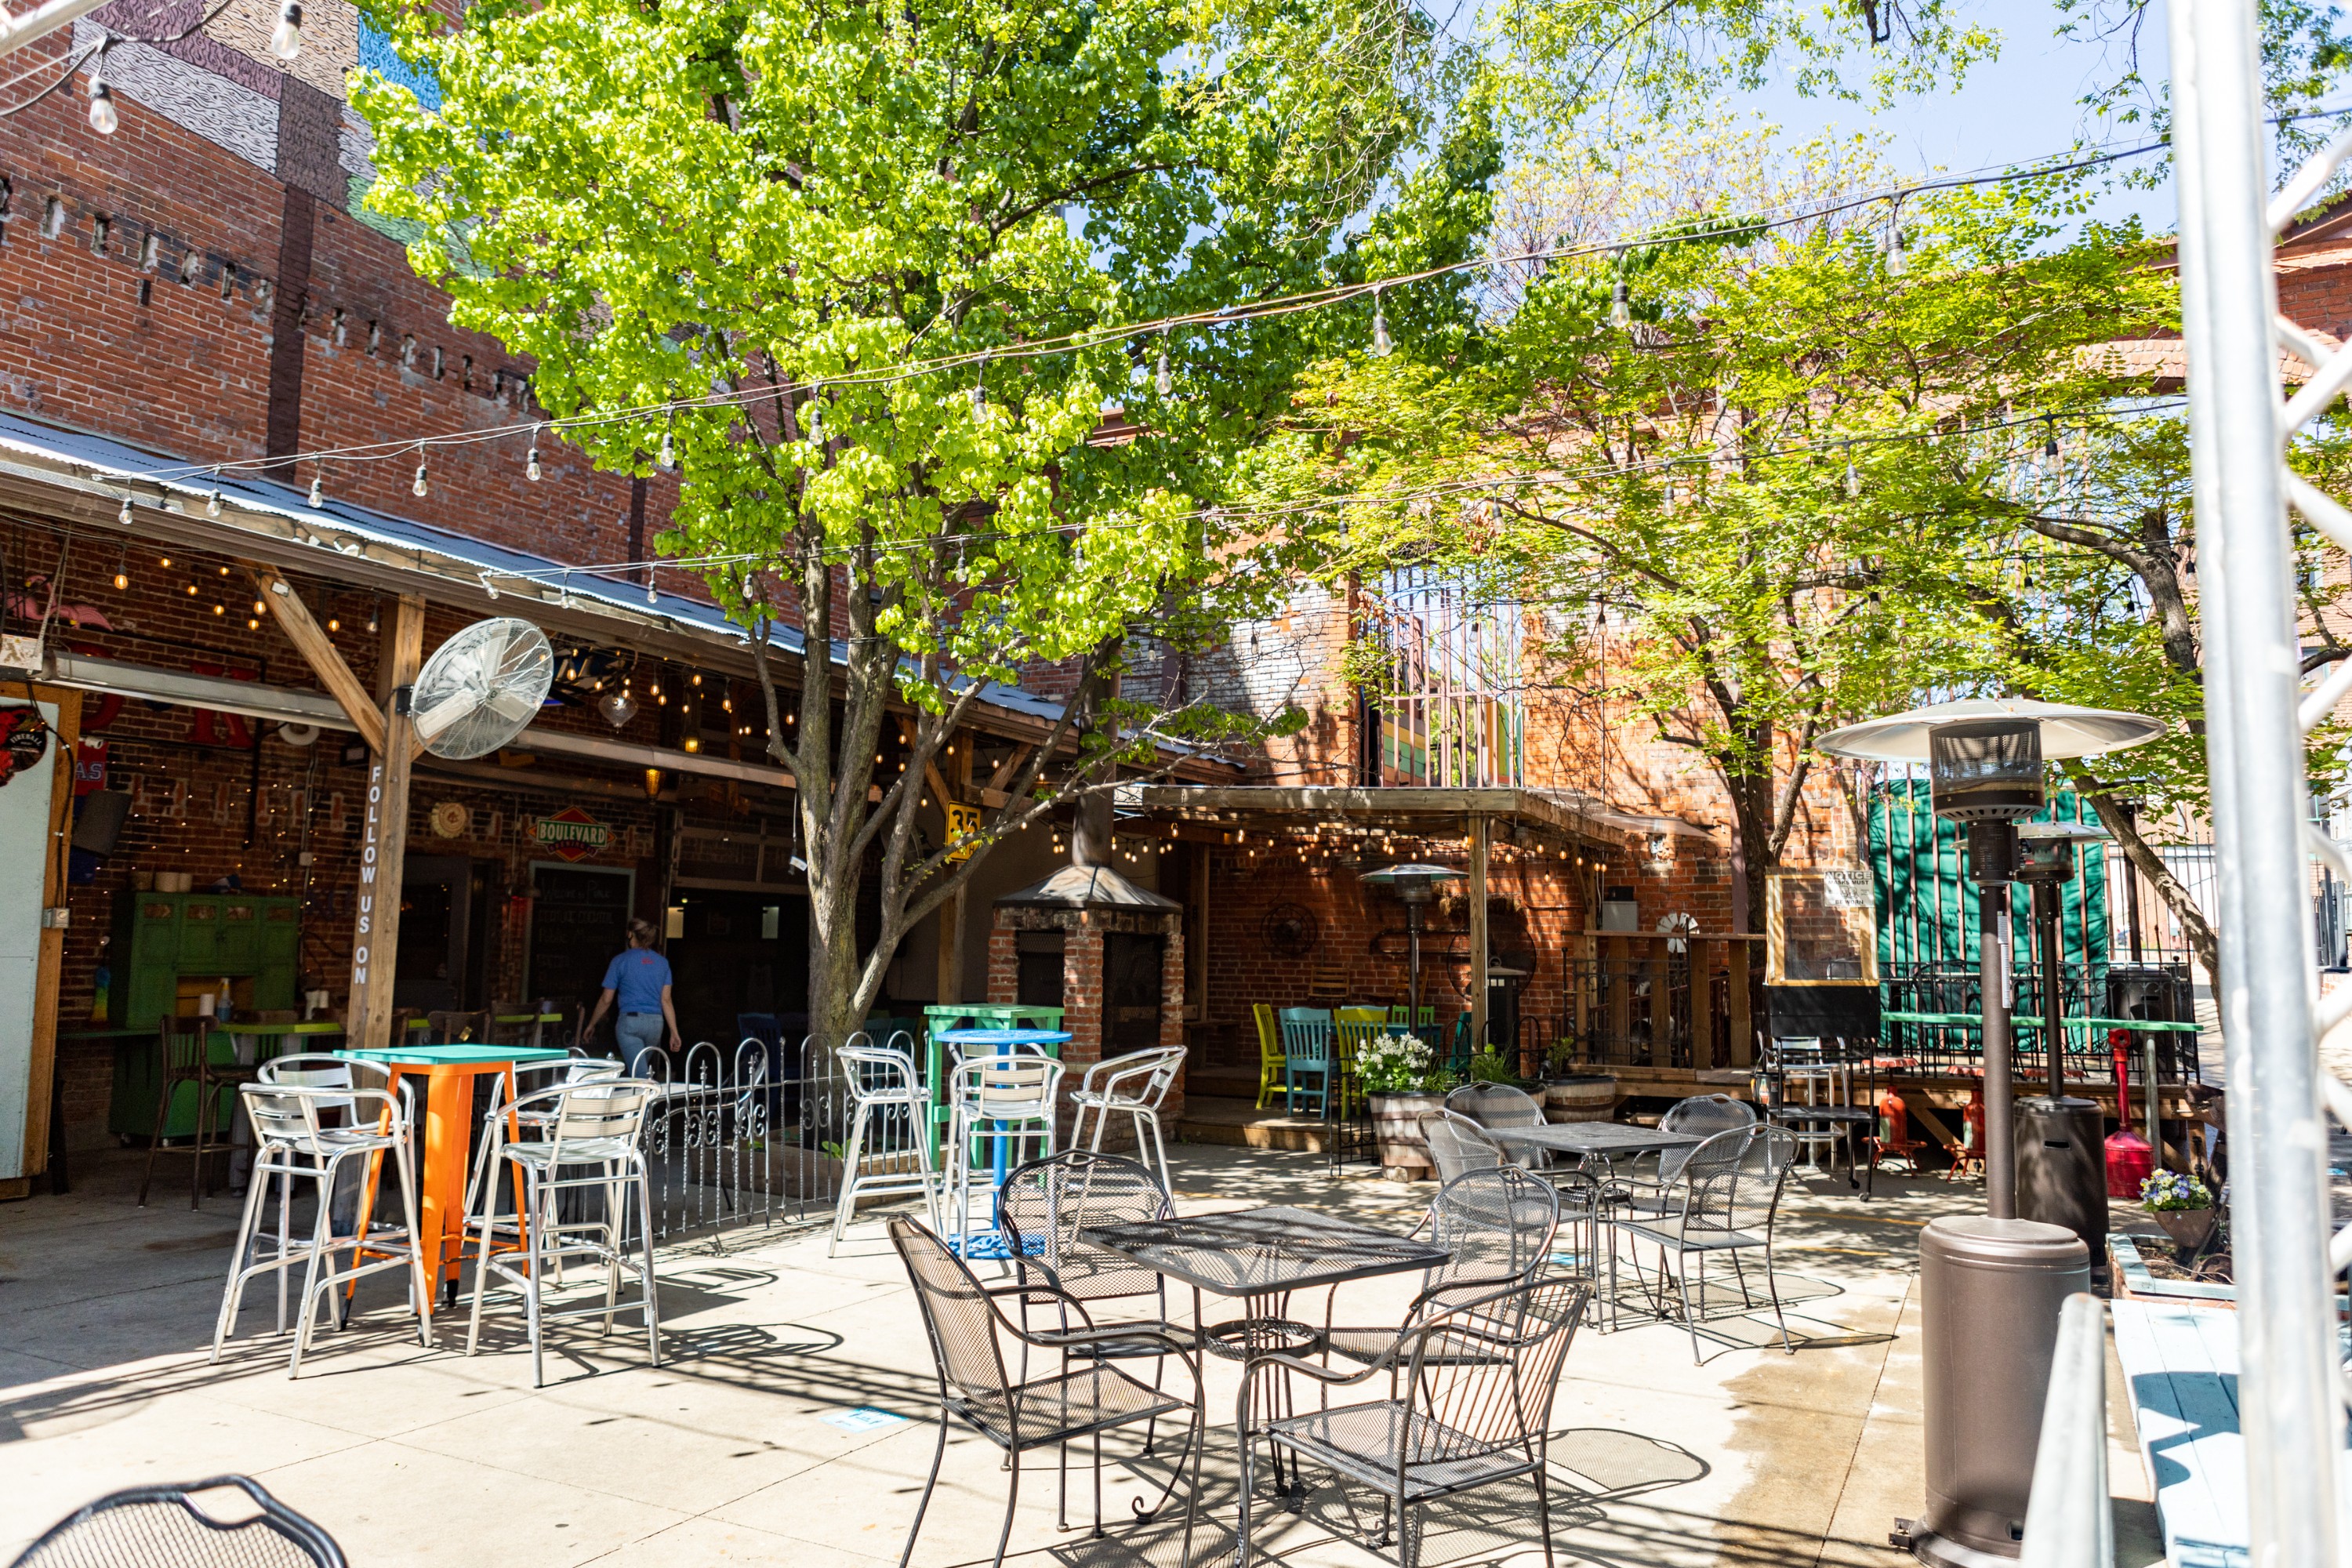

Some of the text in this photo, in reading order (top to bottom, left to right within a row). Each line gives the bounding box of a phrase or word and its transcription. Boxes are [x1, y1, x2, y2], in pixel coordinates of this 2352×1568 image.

[9, 733, 42, 746] FIREBALL
[539, 823, 605, 844] BOULEVARD
[950, 809, 978, 837] 35
[355, 766, 381, 985] FOLLOW US ON
